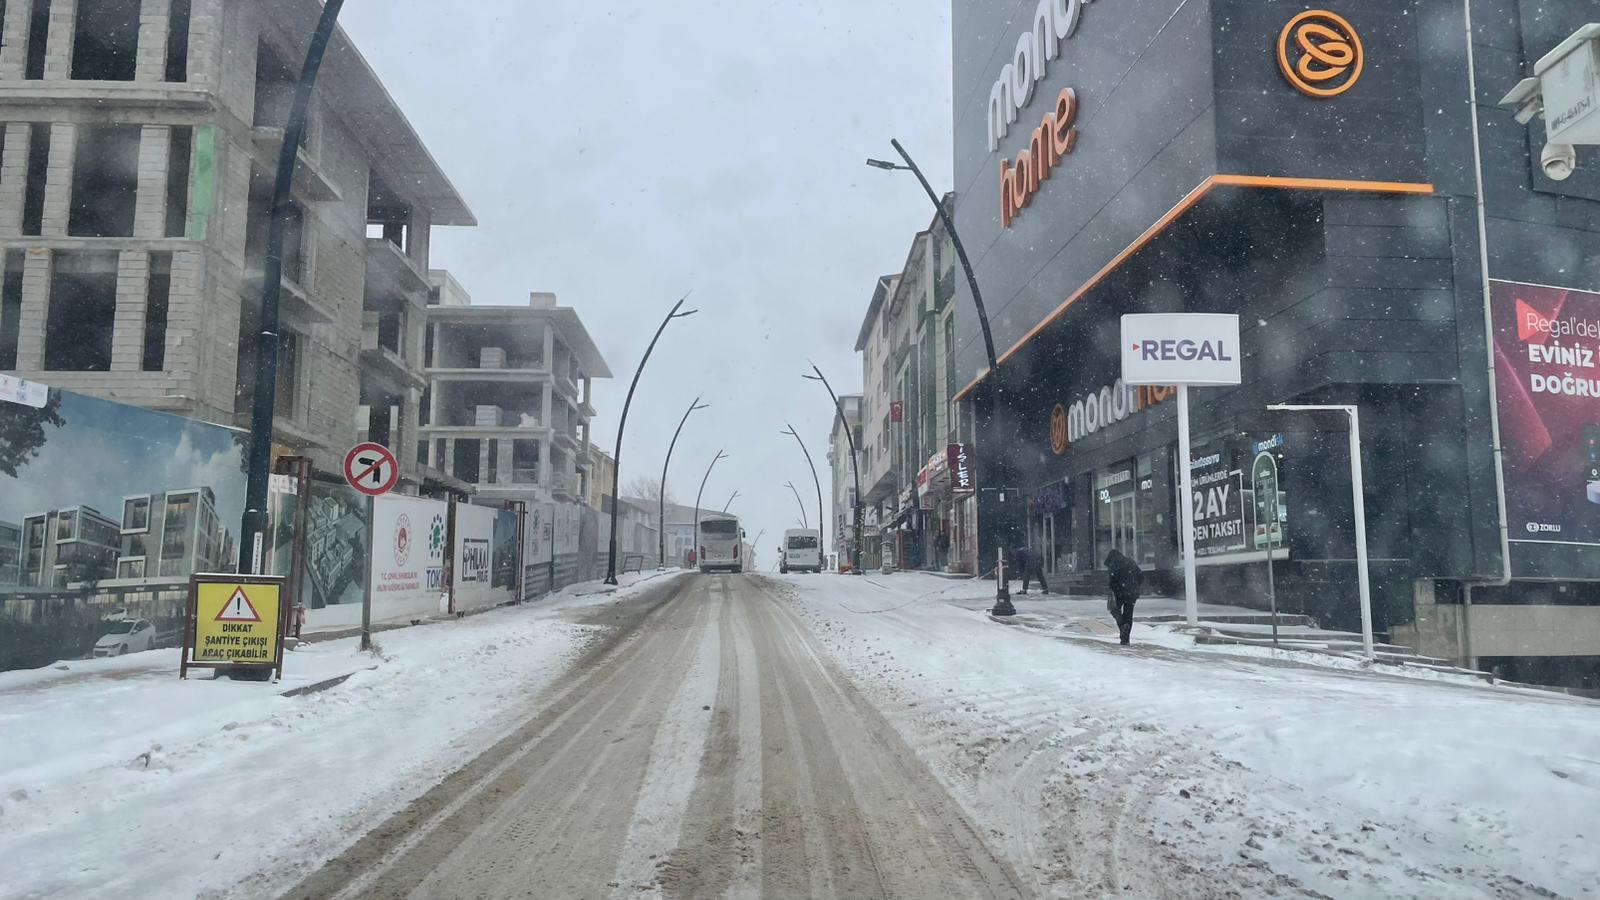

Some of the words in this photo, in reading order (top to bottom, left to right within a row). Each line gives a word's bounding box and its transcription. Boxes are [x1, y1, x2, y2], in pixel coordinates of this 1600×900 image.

[1001, 87, 1076, 229] home
[1142, 340, 1232, 361] REGAL
[1528, 340, 1595, 368] EVİNİZ
[1531, 371, 1600, 398] DOĞRU
[1206, 484, 1229, 518] AY
[1210, 519, 1241, 538] TAKSİT
[222, 622, 253, 633] DİKKAT
[205, 634, 240, 646] ŞANTİYE
[242, 637, 268, 647] ÇIKIŞI
[226, 648, 268, 659] ÇIKABİLİR
